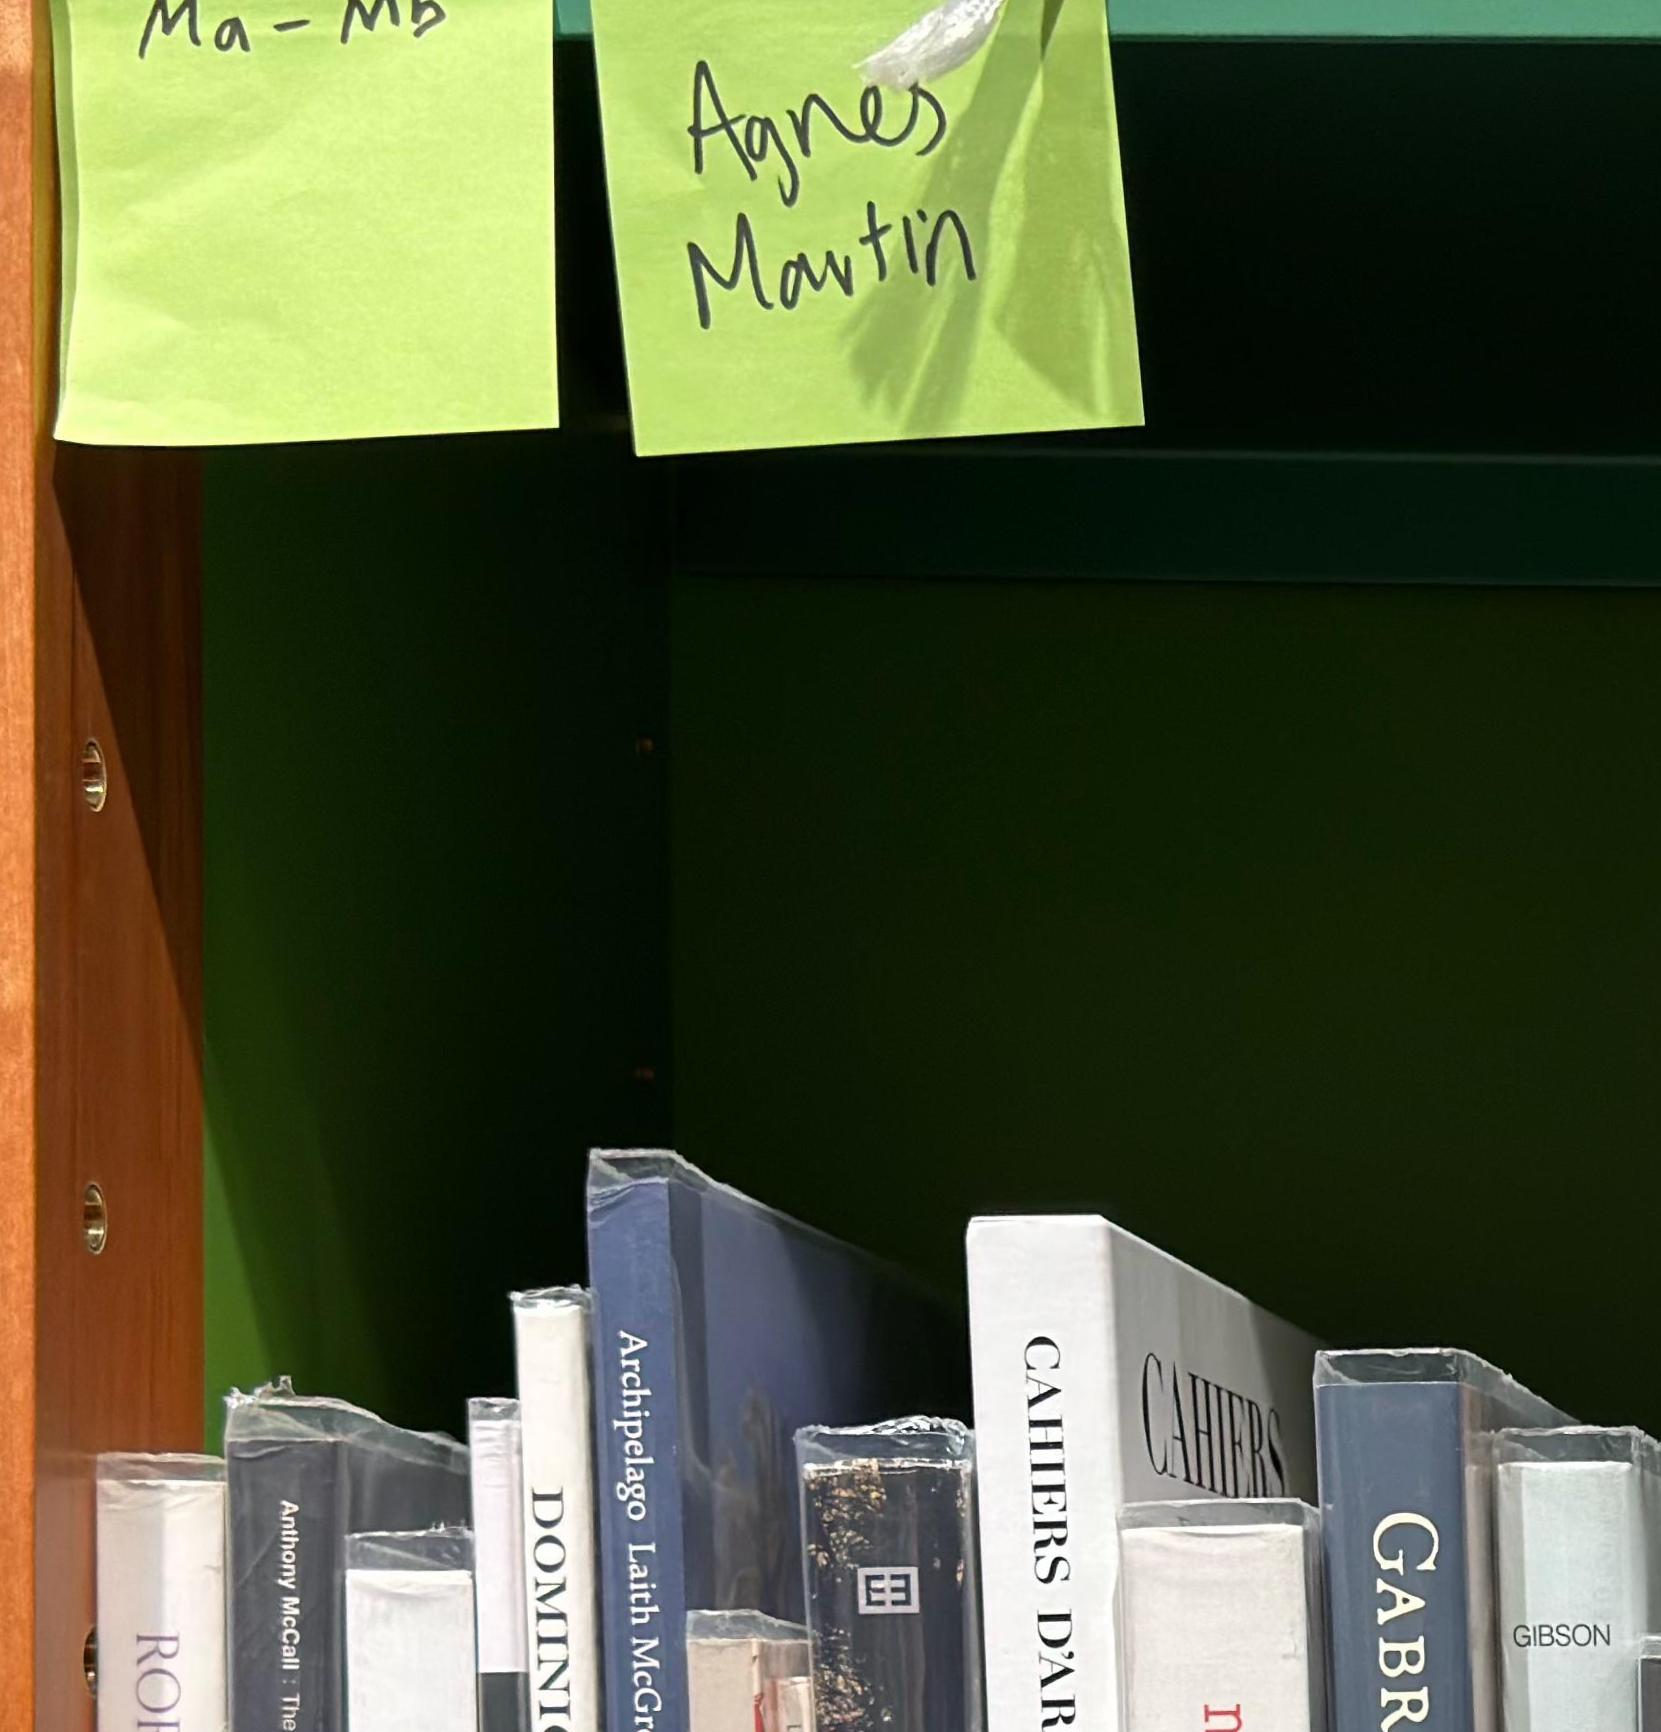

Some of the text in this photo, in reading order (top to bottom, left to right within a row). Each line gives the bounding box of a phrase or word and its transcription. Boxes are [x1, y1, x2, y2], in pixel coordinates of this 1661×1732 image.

[140, 0, 249, 57] Ma
[687, 60, 948, 207] Agnes
[687, 202, 976, 329] Martin
[613, 1330, 654, 1520] Archipelago
[1025, 1336, 1070, 1584] CAHIERS
[1142, 1352, 1286, 1498] CAHIERS
[275, 1500, 299, 1589] Anthony
[628, 1542, 660, 1625] Laith
[280, 1597, 300, 1669] McCall
[1513, 1624, 1611, 1648] GIBSON
[281, 1693, 300, 1731] The
